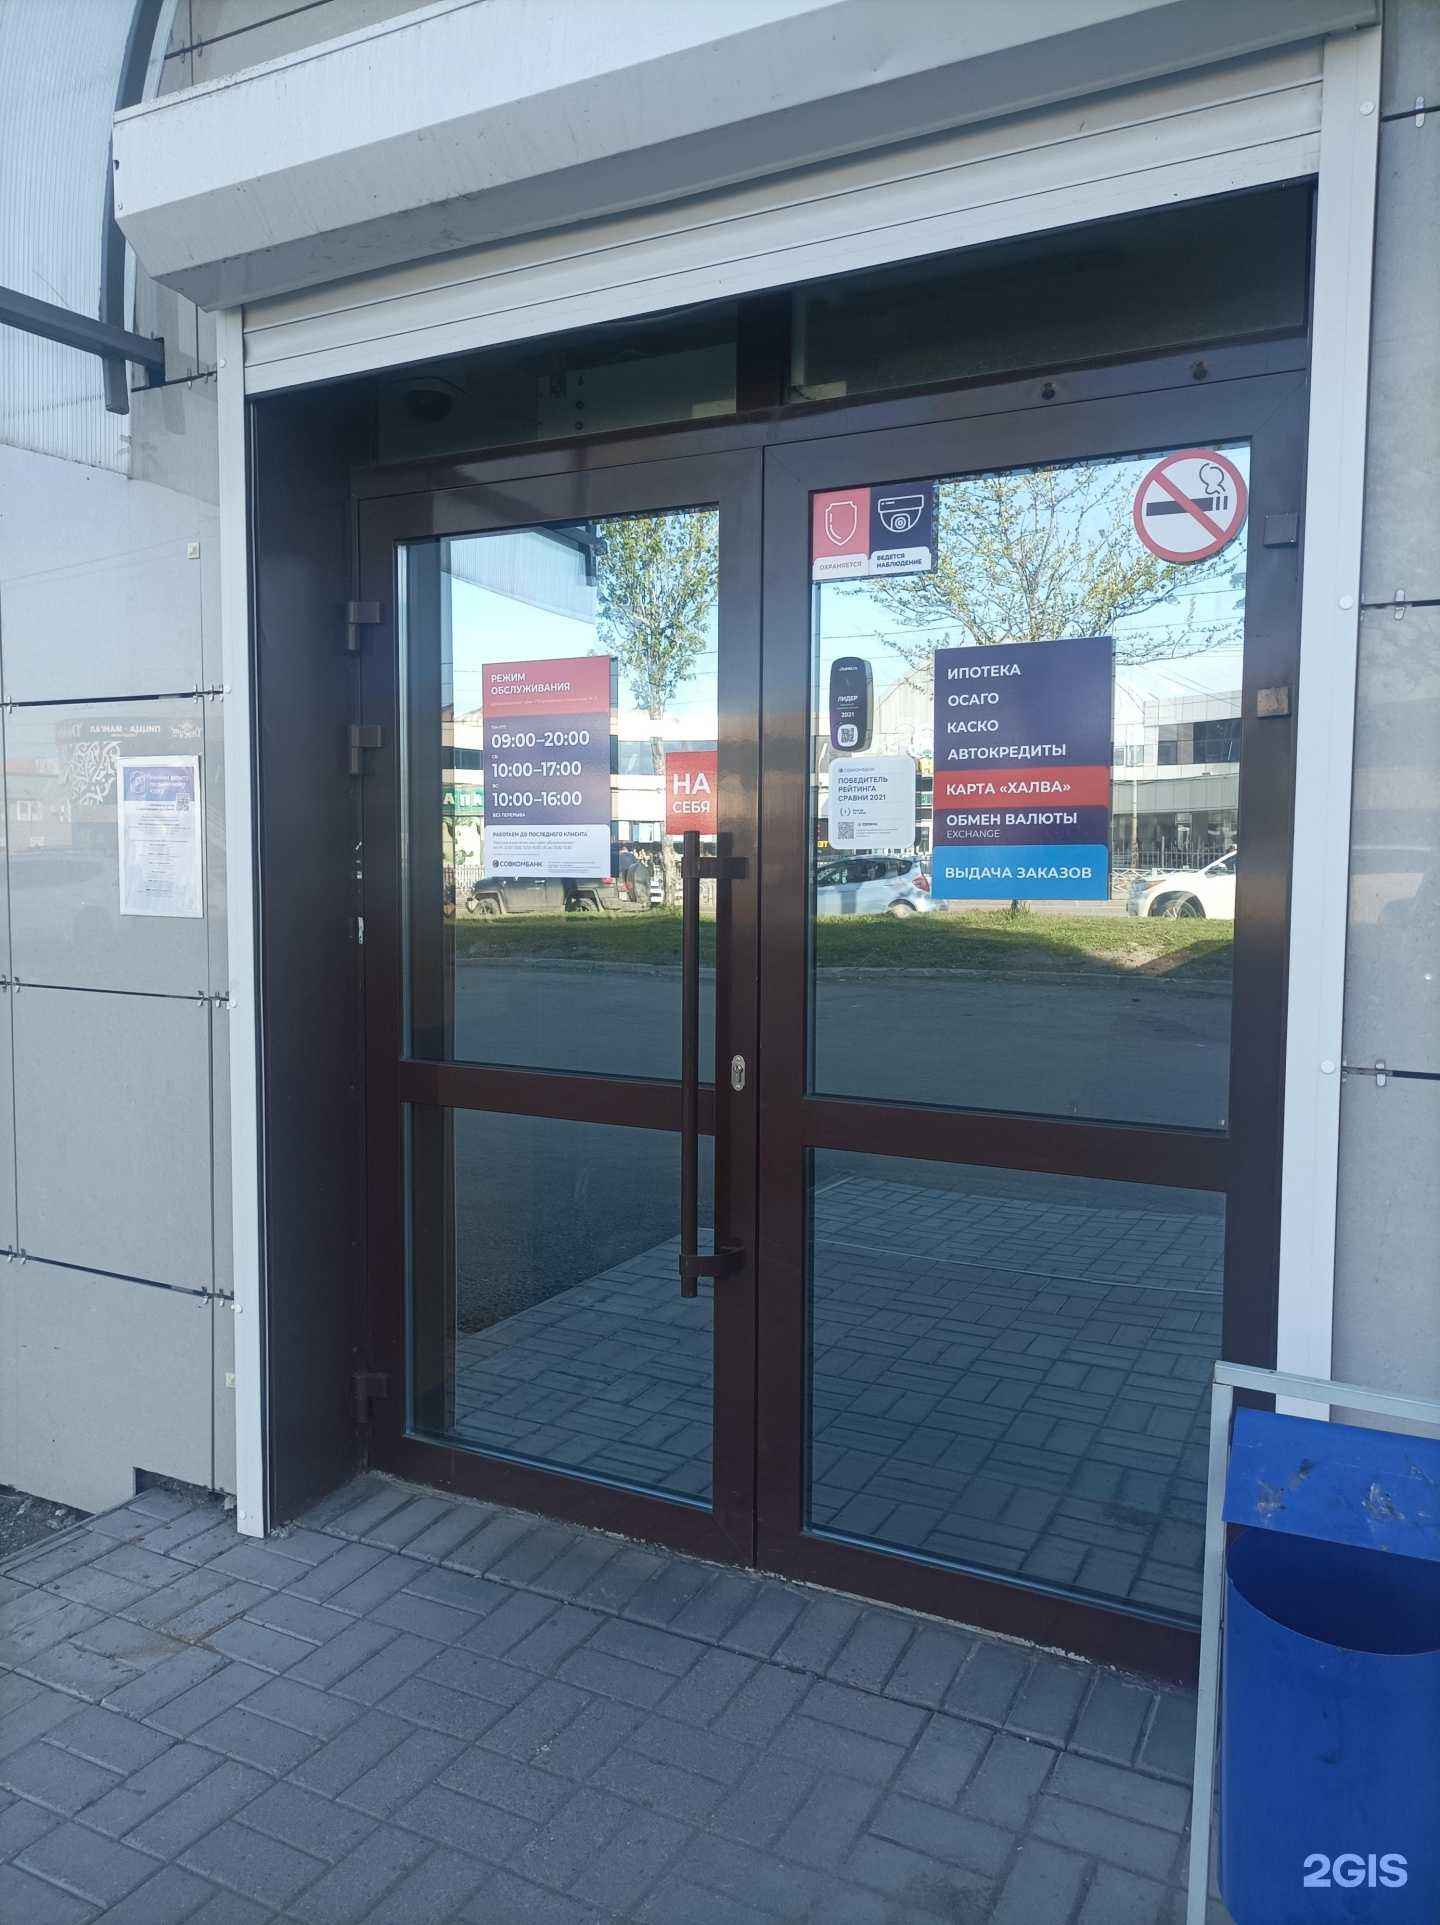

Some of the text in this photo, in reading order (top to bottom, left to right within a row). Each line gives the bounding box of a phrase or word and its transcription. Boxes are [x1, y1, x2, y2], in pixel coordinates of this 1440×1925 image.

[819, 561, 862, 570] ОХРАНЯЕТСЯ
[876, 559, 922, 569] НАБЛЮДЕНИЕ
[491, 673, 526, 683] РЕЖИМ
[947, 664, 1022, 680] ИПОТЕКА
[491, 682, 571, 695] ОБСЛУЖИВАНИЯ
[947, 692, 1000, 707] ОСАГО
[947, 719, 999, 734] КАСКО
[947, 744, 1067, 761] АВТОКРЕДИТЫ
[672, 773, 711, 795] НА
[838, 776, 889, 784] ПОБЕДИТЕЛЬ
[838, 784, 877, 793] РЕЙТИНГА
[946, 781, 1071, 796] КАРТА «ХАЛВА»
[672, 800, 710, 814] СЕБЯ
[946, 812, 1078, 826] ОБМЕН ВАЛЮТЫ
[946, 829, 1001, 839] EXCHANGE
[945, 867, 1093, 881] ВЫДАЧА ЗАКАЗОВ
